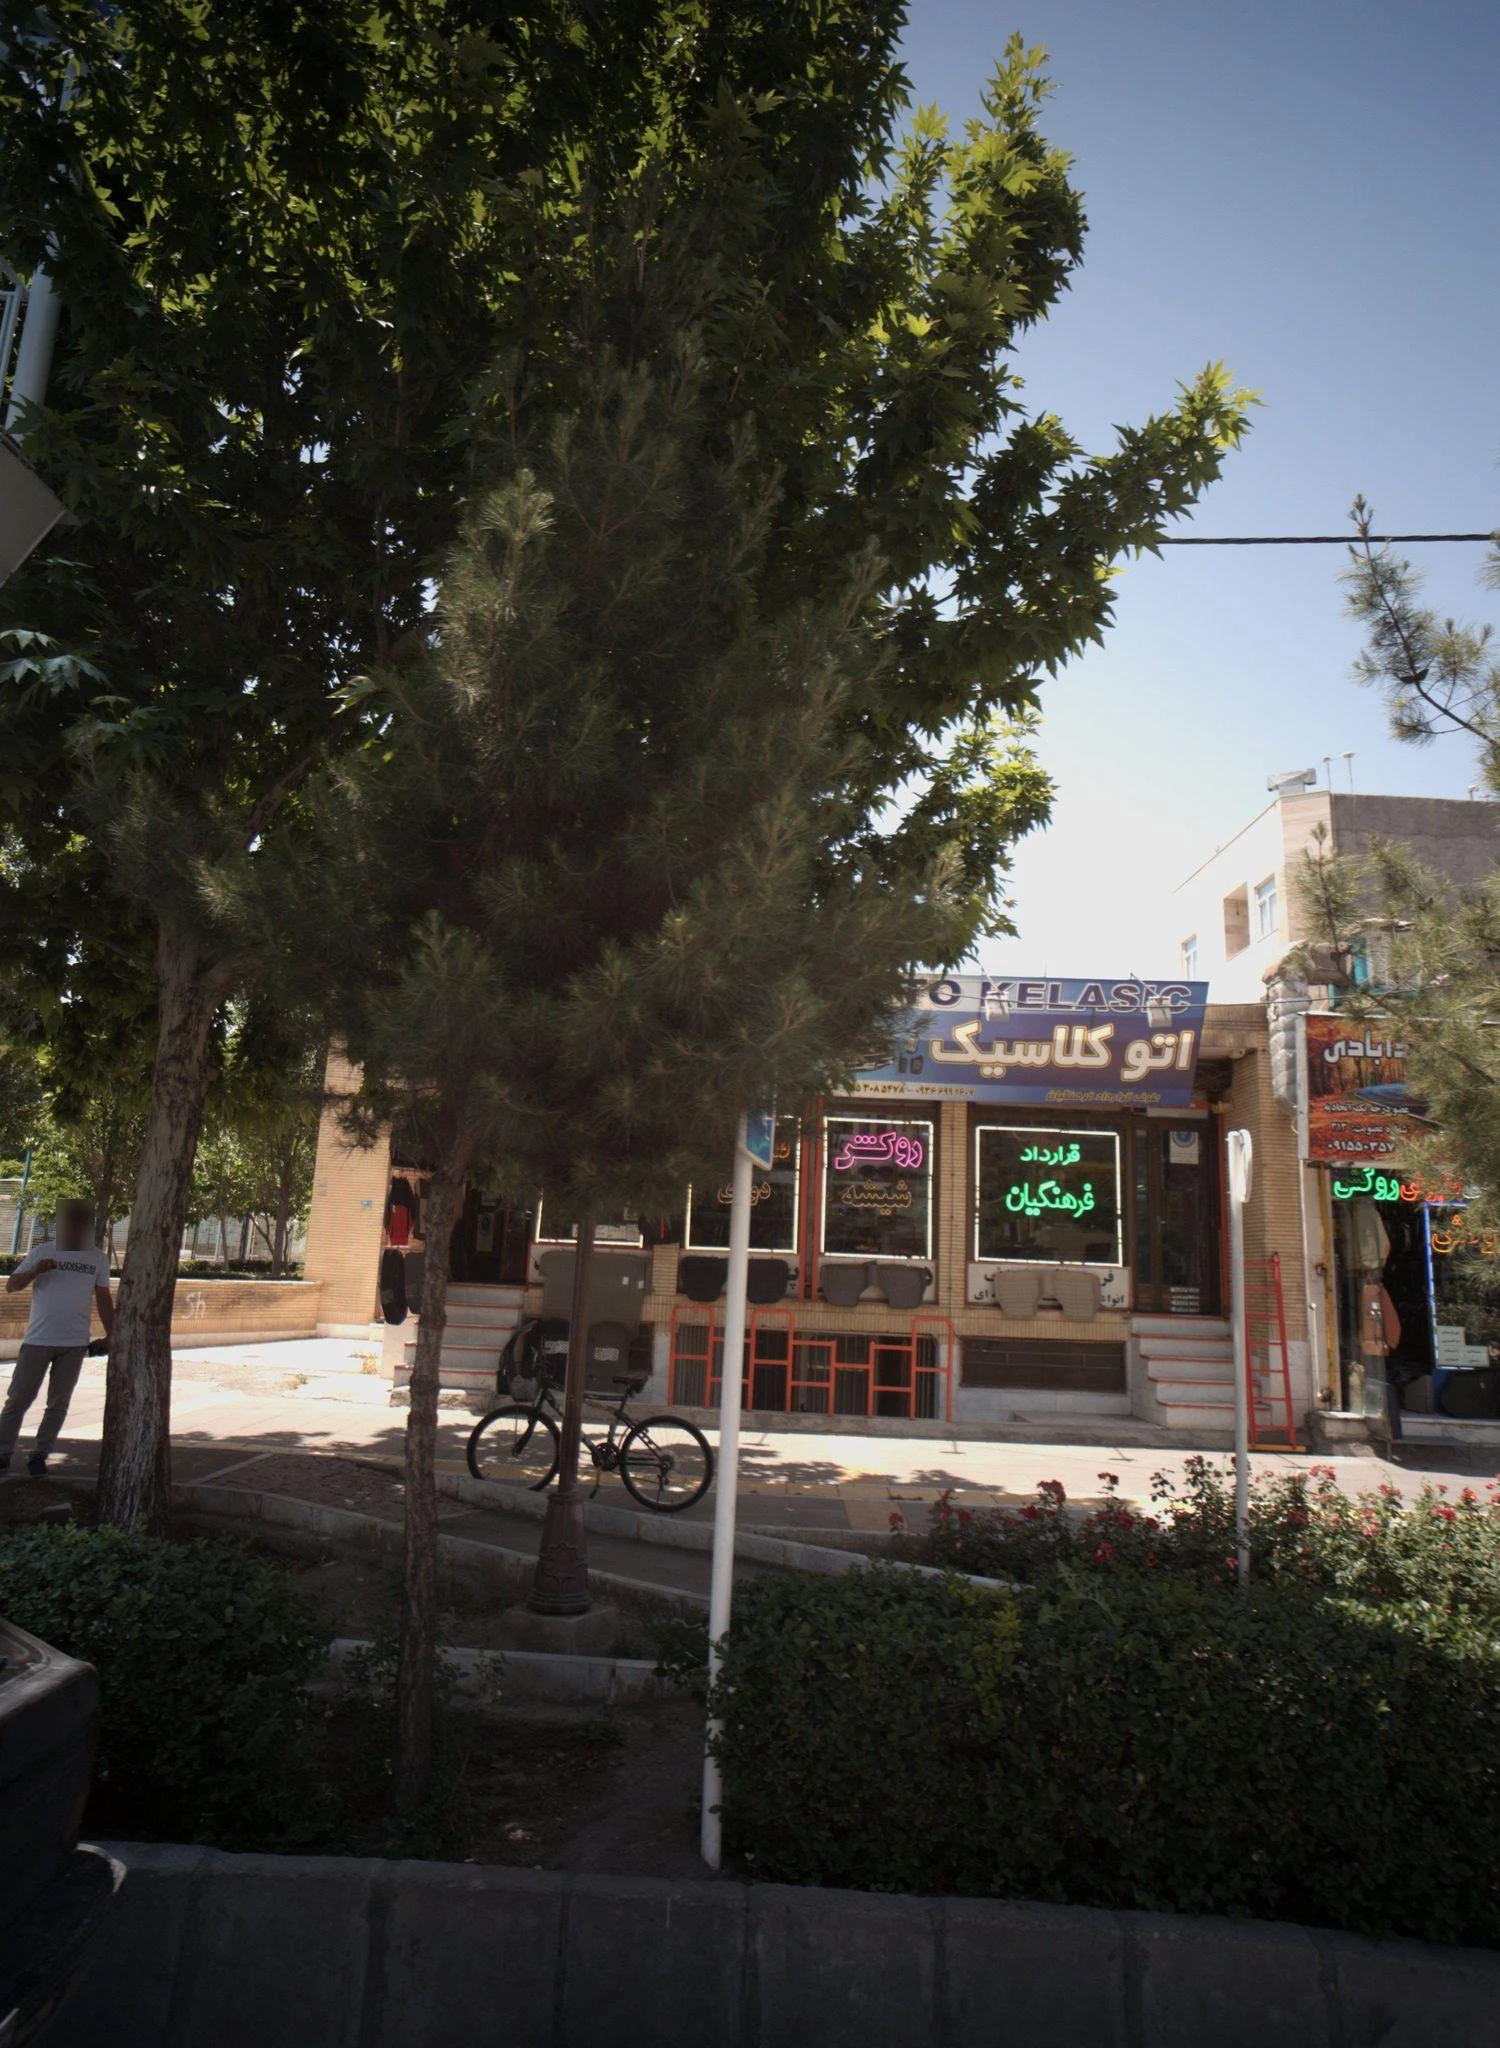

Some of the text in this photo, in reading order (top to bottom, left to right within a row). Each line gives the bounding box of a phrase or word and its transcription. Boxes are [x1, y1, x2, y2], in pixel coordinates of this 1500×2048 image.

[928, 1020, 1195, 1082] اتو کلاسیک
[1019, 1143, 1081, 1166] قرارداد
[841, 1179, 913, 1216] شیشه
